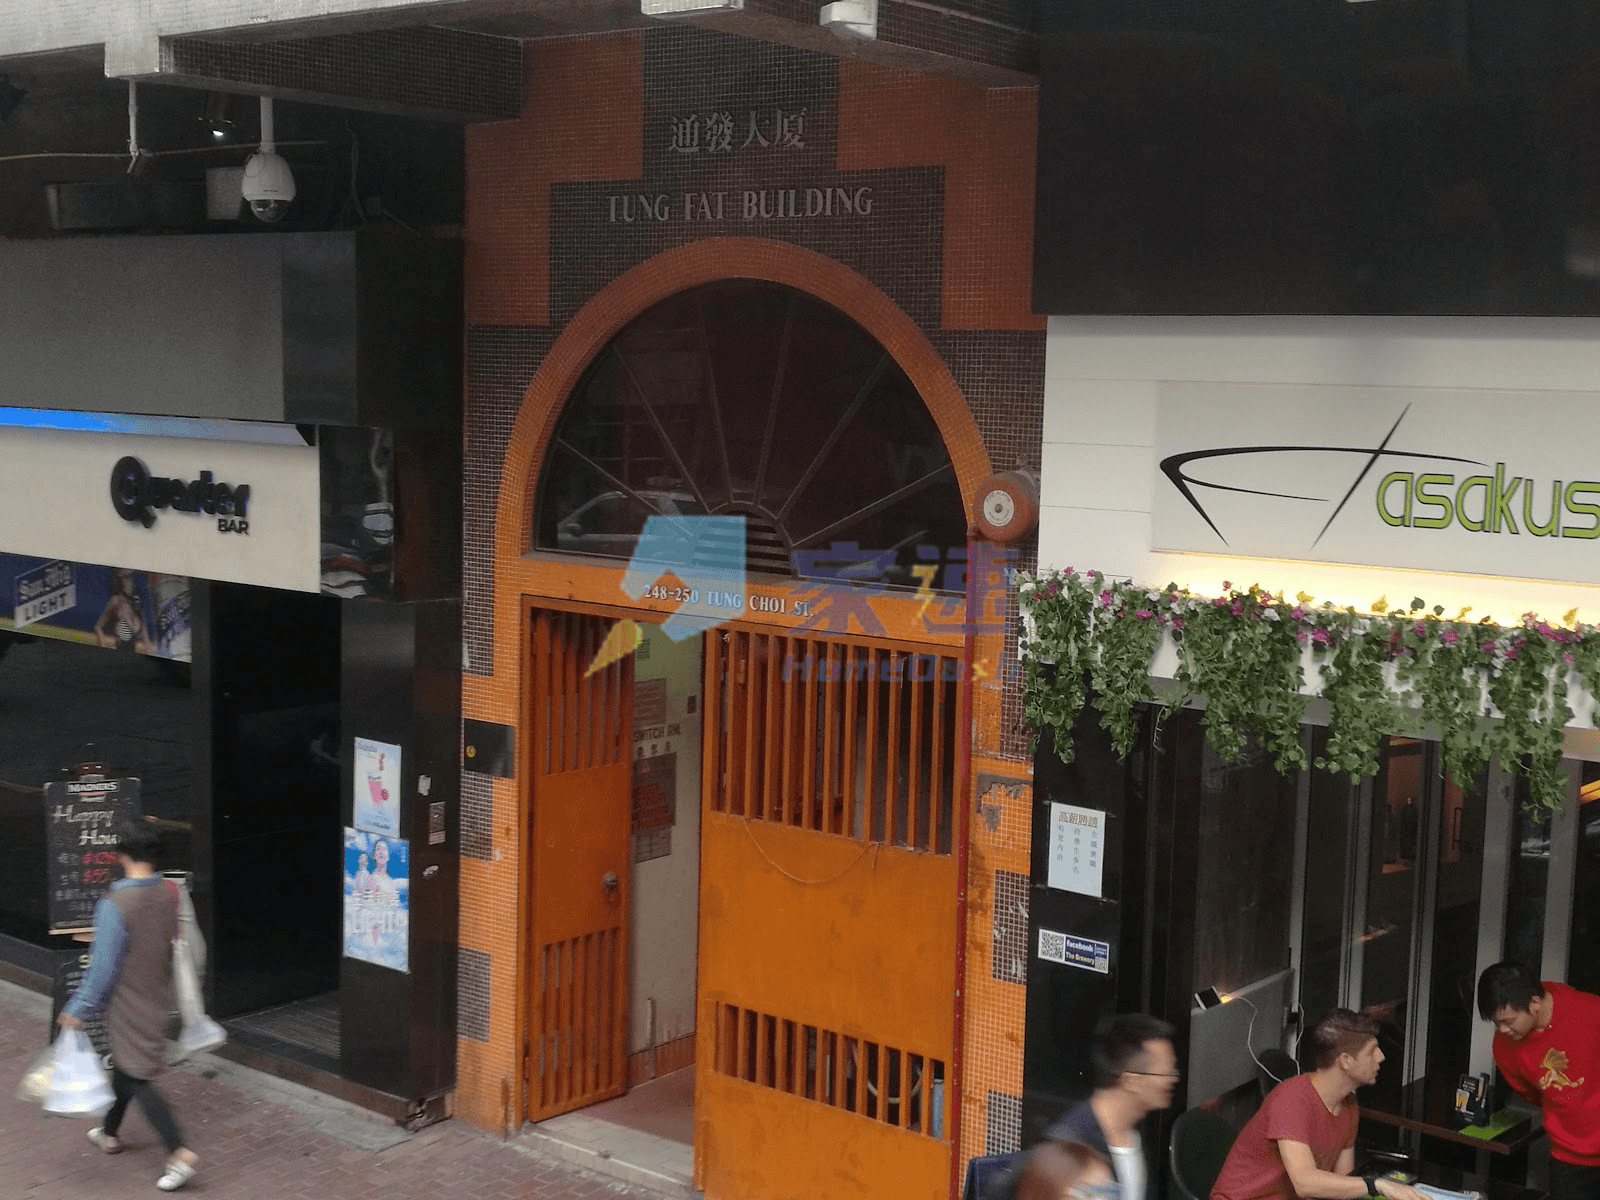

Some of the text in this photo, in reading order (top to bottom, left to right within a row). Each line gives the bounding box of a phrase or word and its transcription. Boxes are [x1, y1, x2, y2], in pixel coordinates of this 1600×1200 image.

[606, 187, 873, 223] TUNG FAT BUILDING
[1376, 462, 1600, 540] asakus
[217, 518, 250, 535] BAR
[24, 592, 68, 622] LIGHT
[643, 584, 814, 617] 248-250 TUNG CHOI ST.
[53, 804, 115, 829] Happy
[1066, 939, 1094, 953] facebook
